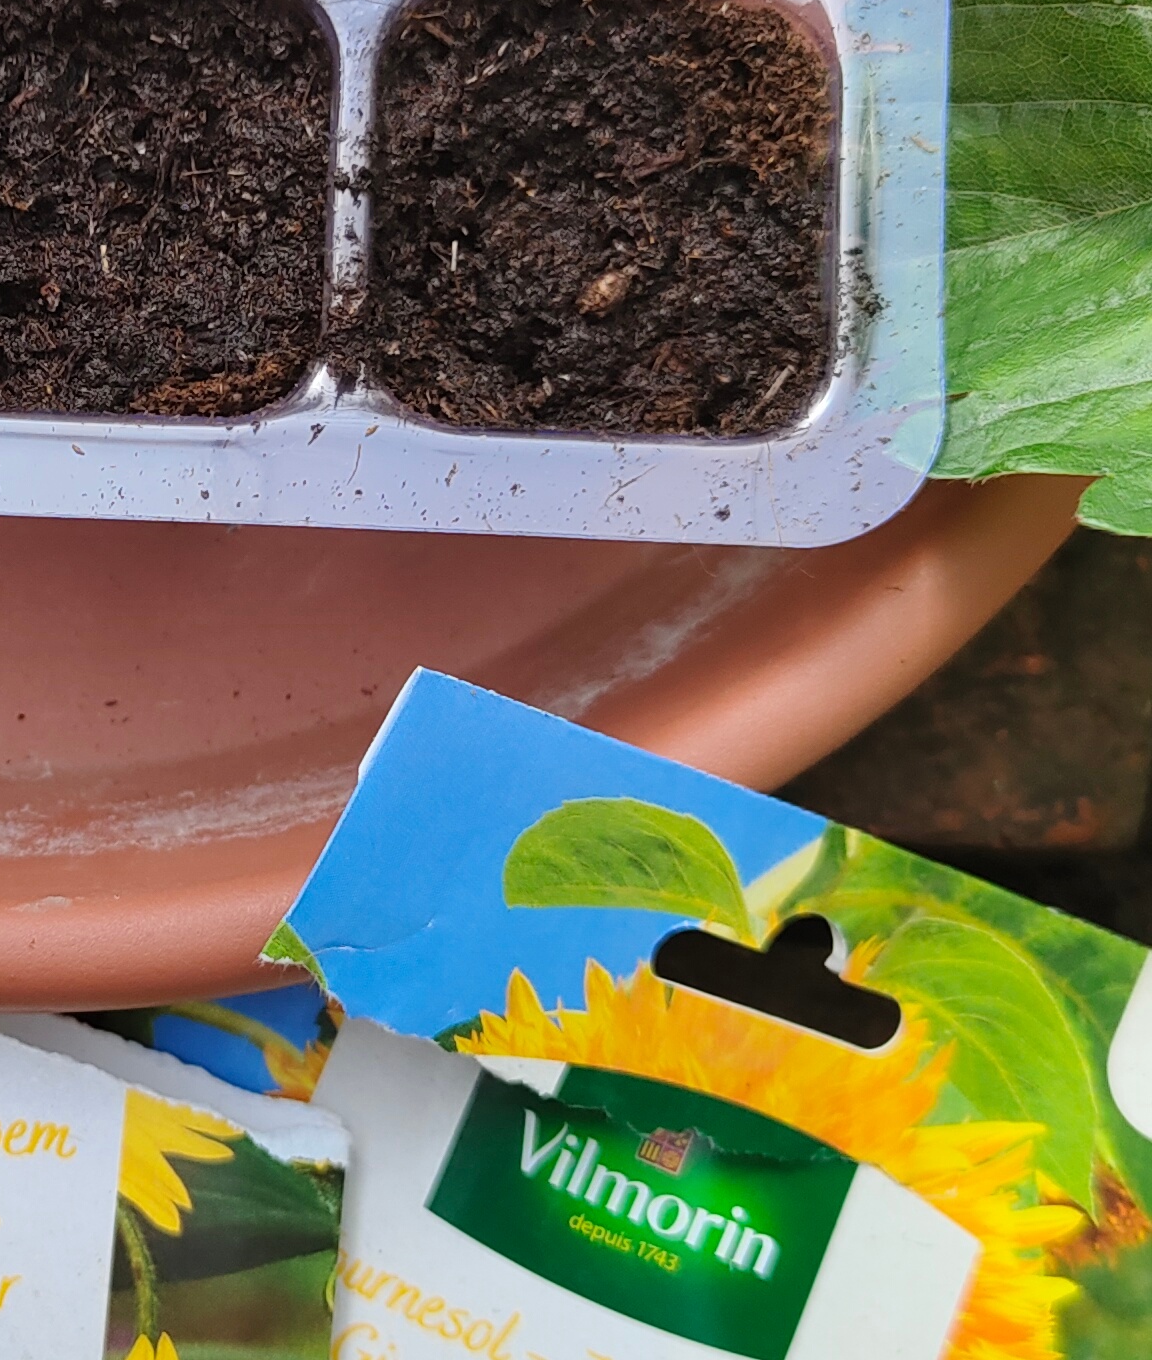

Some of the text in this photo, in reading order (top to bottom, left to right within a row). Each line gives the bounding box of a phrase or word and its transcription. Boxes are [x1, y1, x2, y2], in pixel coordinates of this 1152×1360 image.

[520, 1108, 780, 1281] Vilmorin
[568, 1213, 681, 1273] depuis 1743
